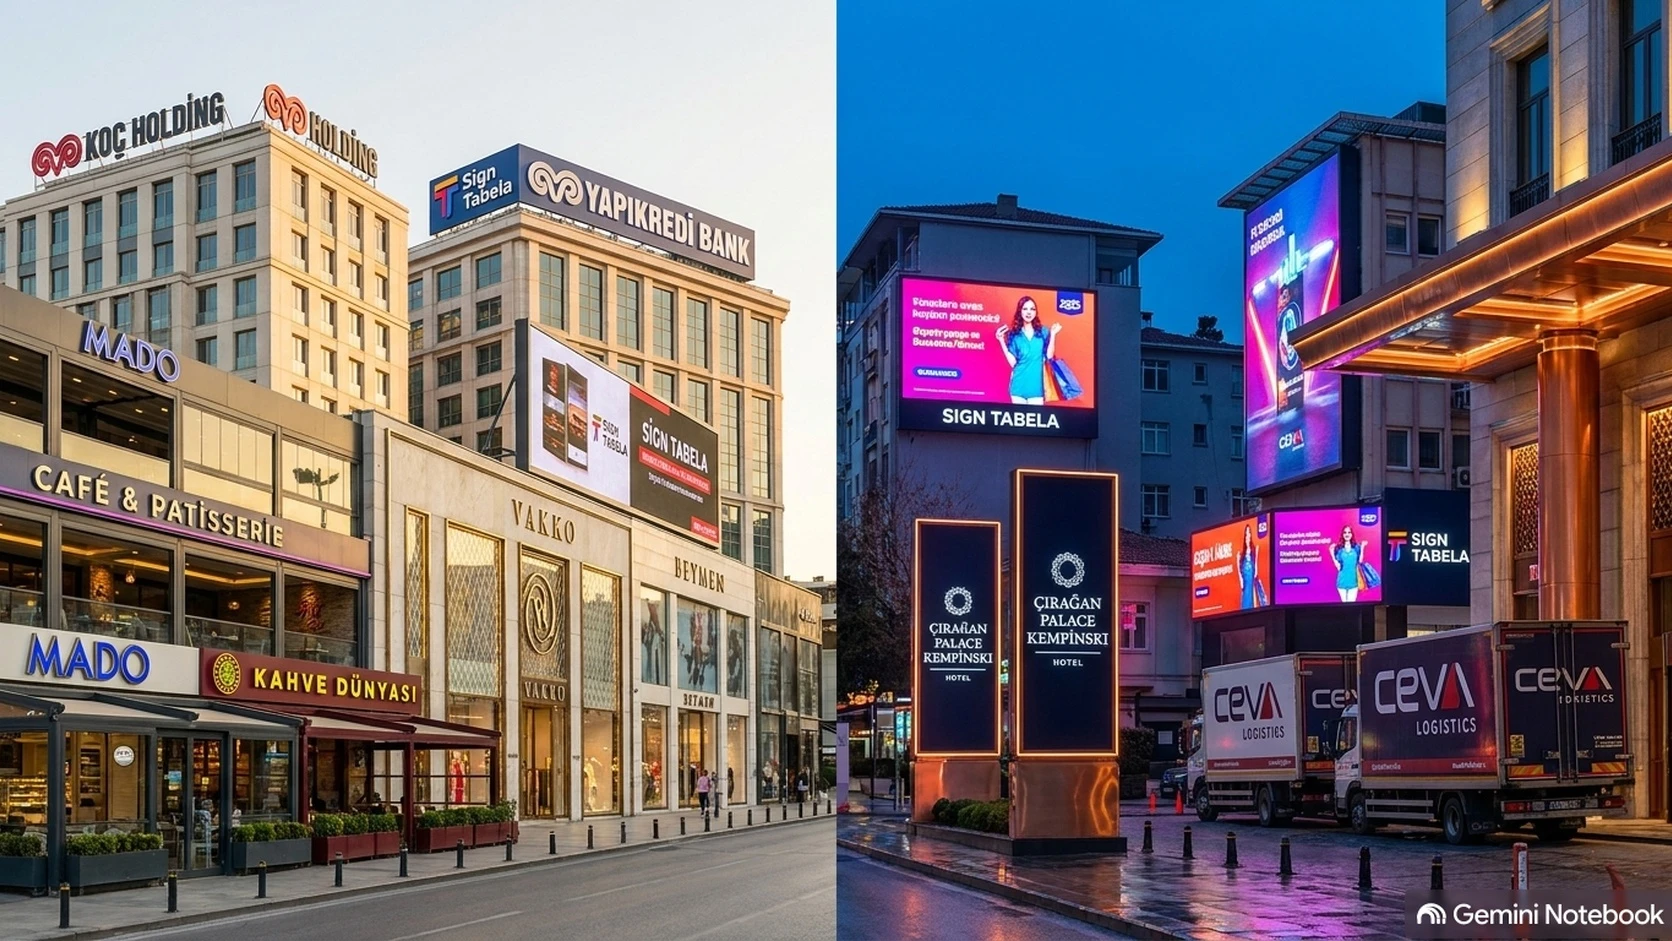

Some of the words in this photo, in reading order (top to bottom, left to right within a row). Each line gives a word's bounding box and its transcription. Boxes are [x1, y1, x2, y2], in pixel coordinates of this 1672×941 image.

[85, 123, 127, 158] KOÇ
[133, 91, 225, 149] HOLDİNG
[462, 165, 496, 190] Sign
[462, 180, 513, 210] Tabela
[698, 226, 750, 267] BANK
[82, 319, 180, 383] MADO
[942, 408, 987, 426] SIGN
[990, 410, 1060, 430] TABELA
[670, 435, 709, 474] TABELA
[34, 465, 109, 507] CAFÉ
[122, 486, 138, 515] &
[512, 498, 576, 545] VAKKO
[1411, 532, 1448, 547] SIGN
[1412, 547, 1470, 564] TABELA
[674, 555, 725, 595] BEYMEN
[1034, 593, 1102, 613] ÇIRAĞAN
[1040, 614, 1096, 628] PALACE
[934, 637, 983, 649] PALACE
[26, 632, 151, 686] MADO
[1053, 658, 1083, 667] HOTEL
[253, 667, 328, 696] KAHVE
[336, 674, 418, 703] DÜNYASI
[945, 674, 971, 682] HOTEL
[1416, 716, 1477, 737] LOGISTICS
